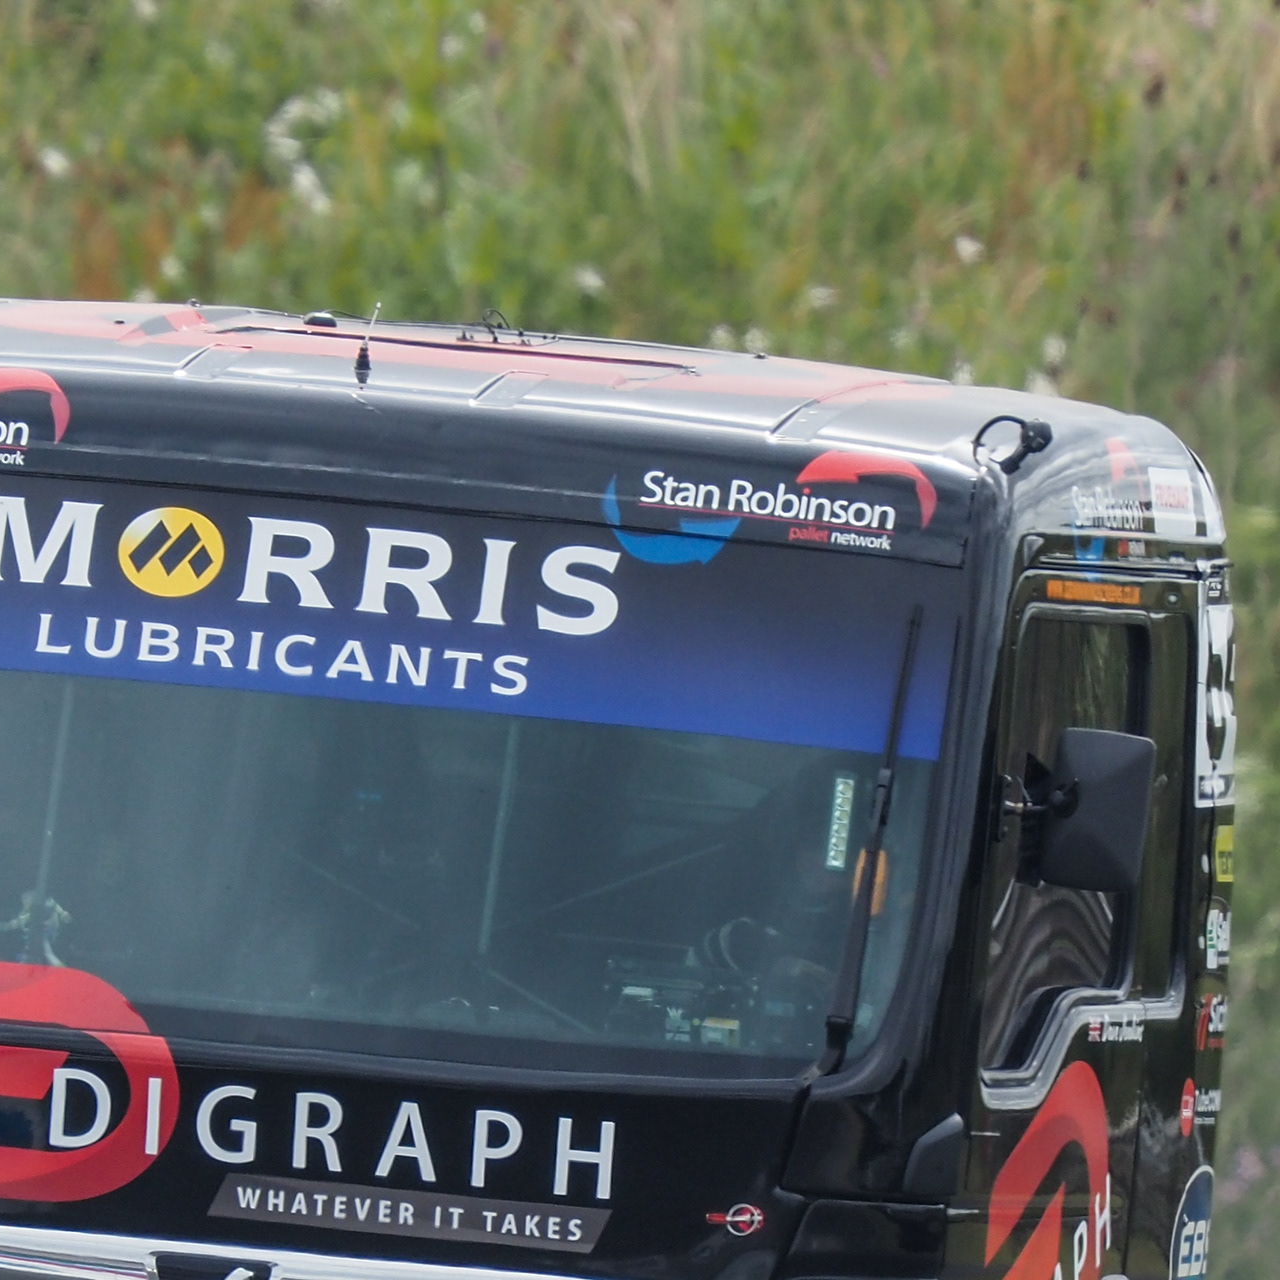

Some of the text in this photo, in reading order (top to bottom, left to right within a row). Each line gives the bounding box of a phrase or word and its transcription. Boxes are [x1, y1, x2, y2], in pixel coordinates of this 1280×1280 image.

[638, 470, 896, 531] Stan Robinson
[788, 525, 892, 551] pallet network
[34, 613, 530, 696] LUBRICANTS
[47, 1066, 616, 1200] DIGRAPH
[236, 1186, 584, 1242] WHATEVER IT TAKES
